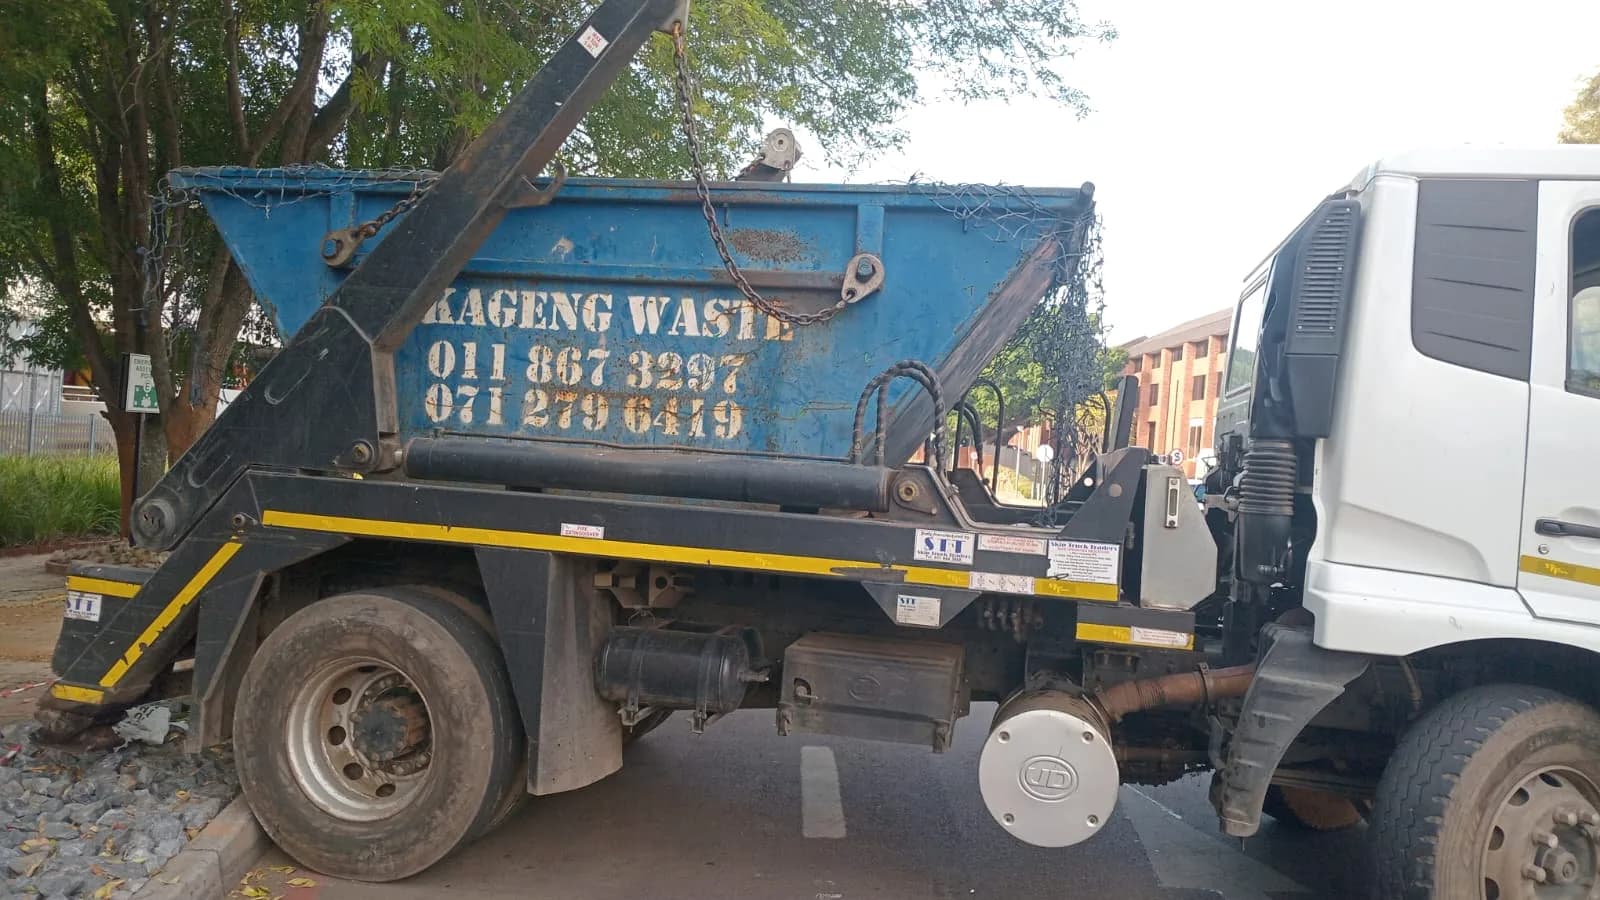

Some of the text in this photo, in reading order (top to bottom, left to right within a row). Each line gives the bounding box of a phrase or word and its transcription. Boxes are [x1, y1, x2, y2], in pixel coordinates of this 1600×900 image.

[421, 288, 793, 341] KAGENG WASTE
[428, 340, 749, 394] 011 867 3297
[425, 383, 742, 439] 071 279 6419
